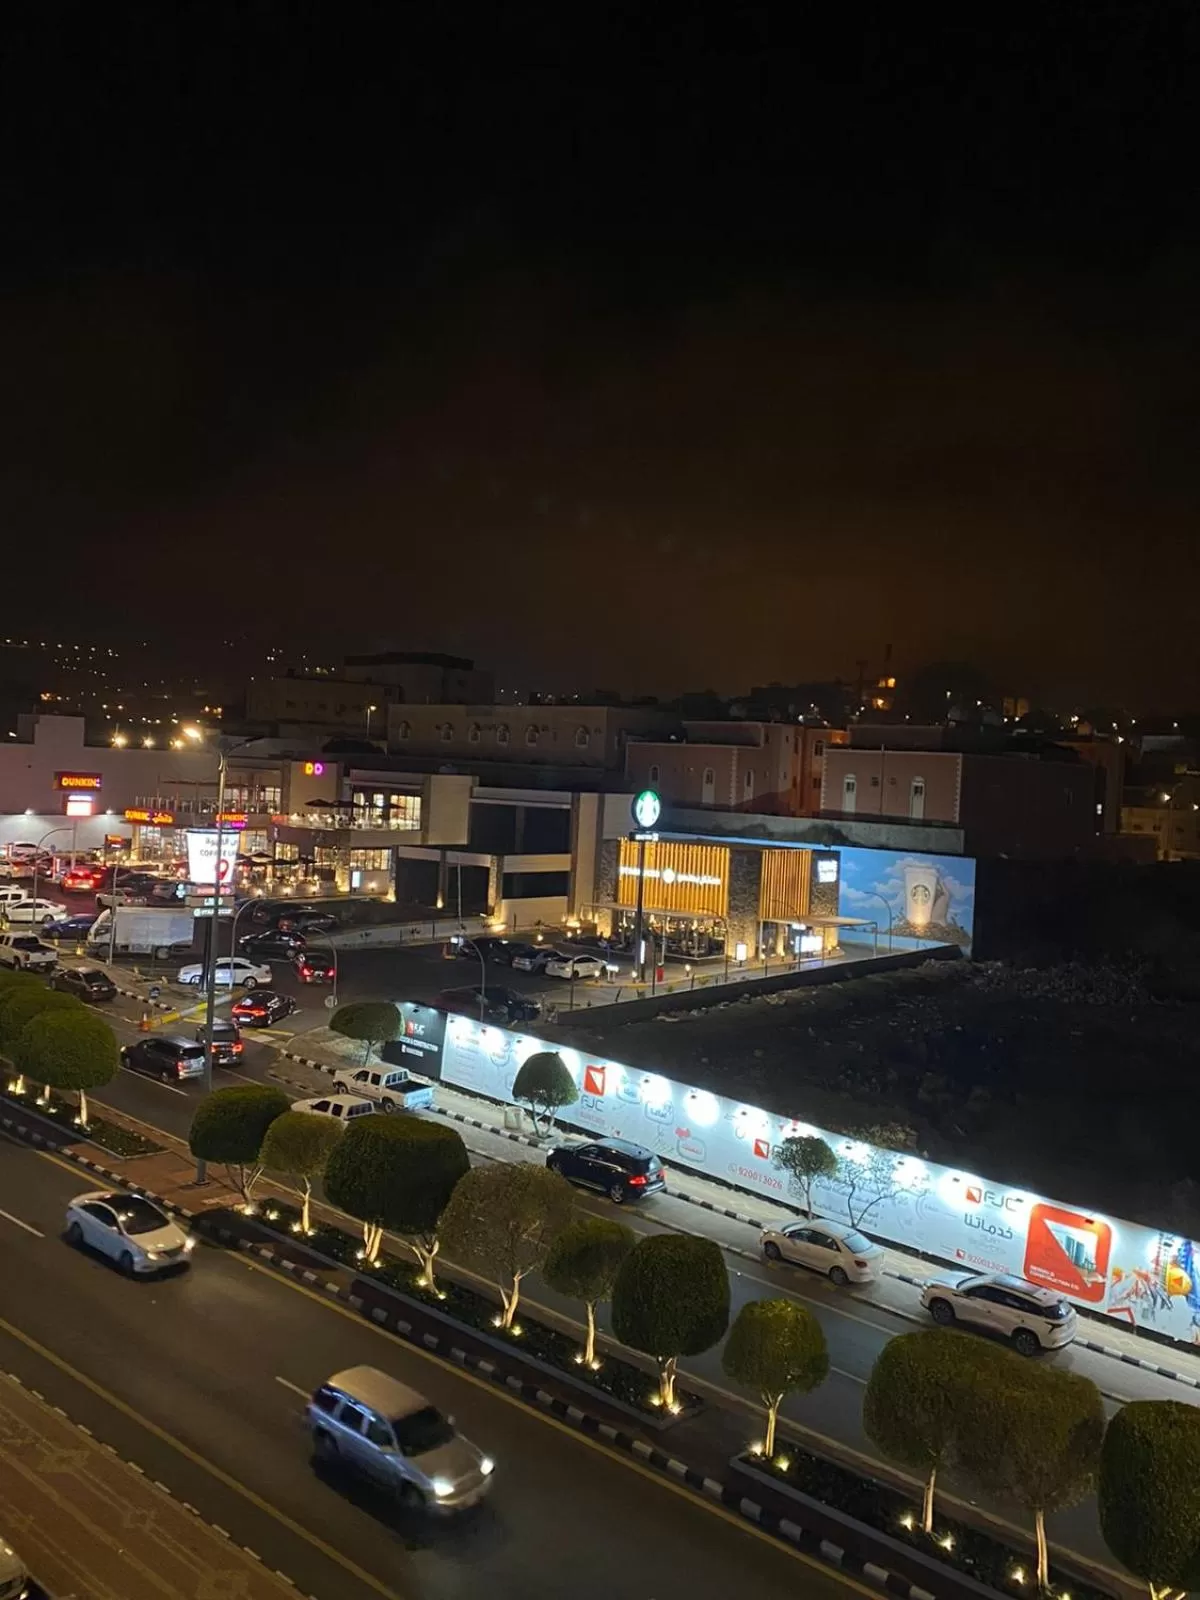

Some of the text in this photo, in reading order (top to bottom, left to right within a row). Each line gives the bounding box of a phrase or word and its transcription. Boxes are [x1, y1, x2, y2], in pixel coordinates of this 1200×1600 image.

[581, 1095, 604, 1112] FJC
[984, 1190, 1018, 1213] FJC
[964, 1212, 1013, 1240] خدماتنا
